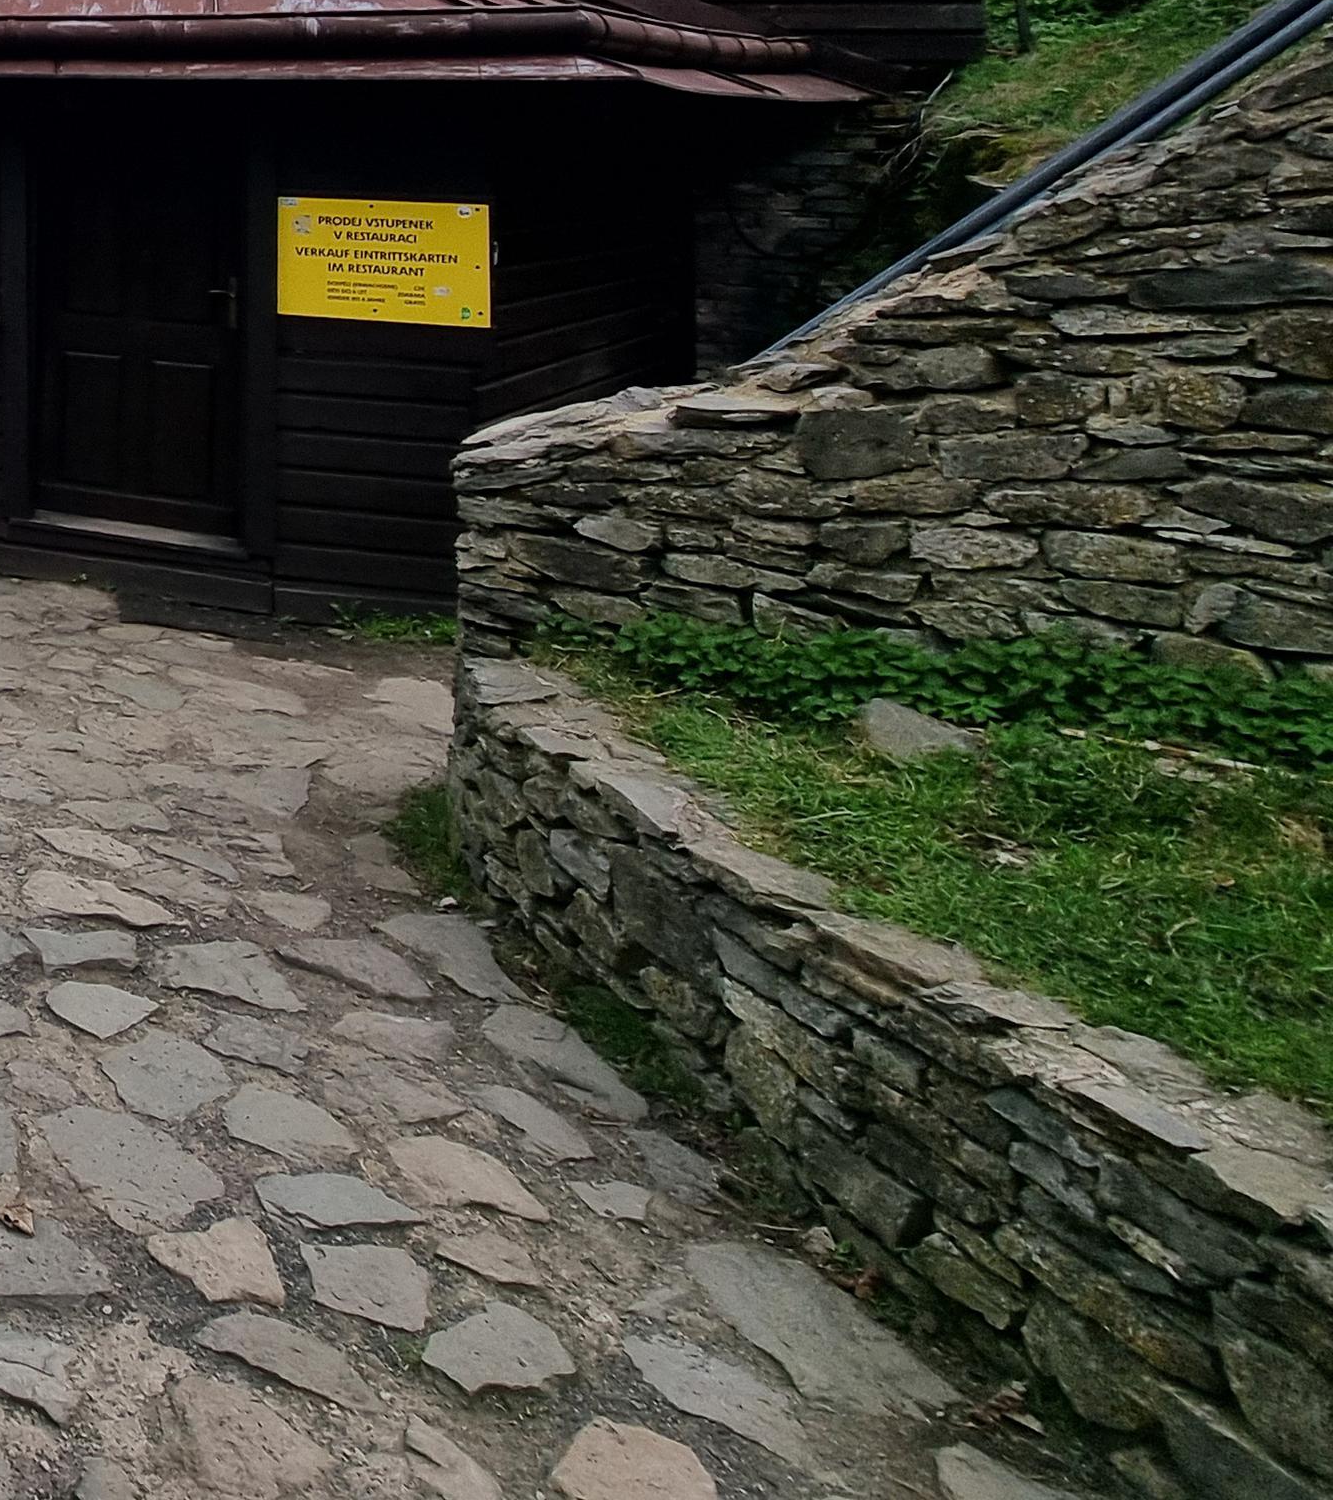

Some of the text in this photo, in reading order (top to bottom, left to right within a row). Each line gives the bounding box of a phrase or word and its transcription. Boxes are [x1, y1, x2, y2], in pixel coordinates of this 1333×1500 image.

[317, 215, 434, 230] PRODEJ VSTUPENEK
[333, 231, 418, 244] V RESTAURACI
[295, 247, 458, 264] VERKAUF EINTRITTSKARTEN
[327, 263, 425, 277] IM RESTAURANT
